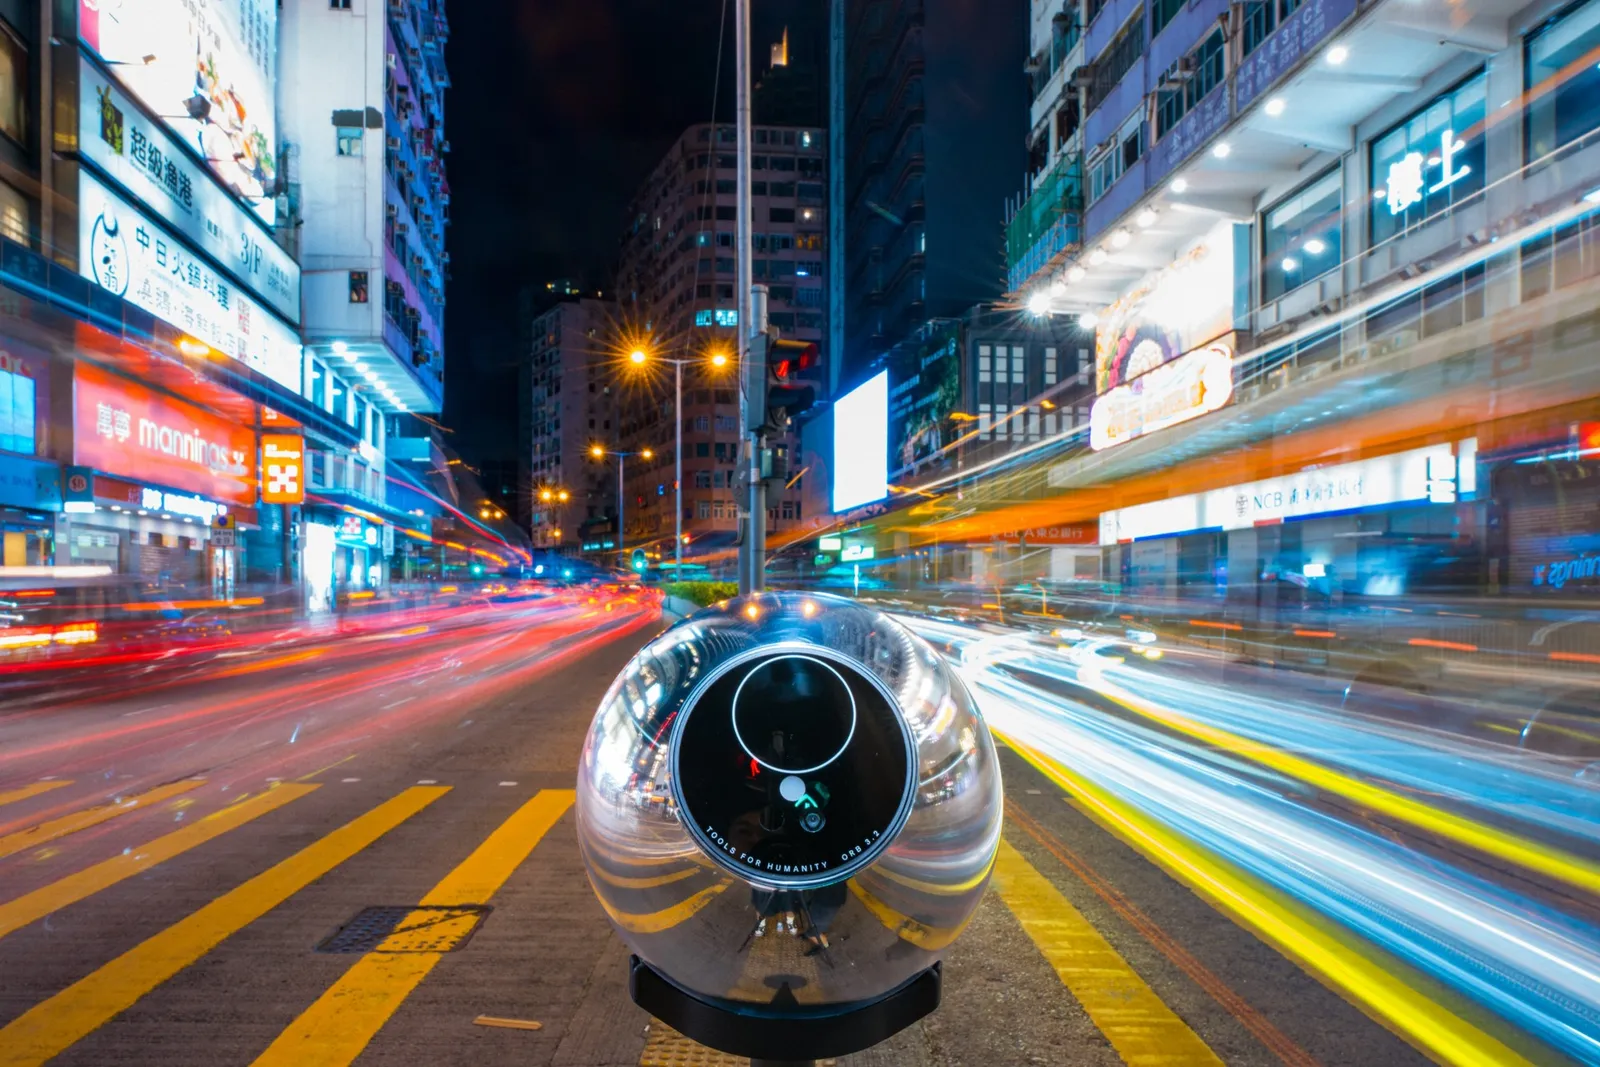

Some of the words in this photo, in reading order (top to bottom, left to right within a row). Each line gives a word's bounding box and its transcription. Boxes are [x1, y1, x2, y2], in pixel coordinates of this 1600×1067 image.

[130, 126, 192, 206] 超級漁港
[240, 232, 263, 275] 3/F
[139, 418, 229, 475] mannings
[1253, 490, 1283, 510] NCB
[706, 825, 737, 855] TOOLS
[739, 852, 762, 868] FOR
[766, 861, 828, 873] HUMANITY
[841, 845, 862, 862] ORB
[864, 829, 881, 846] 3.2
